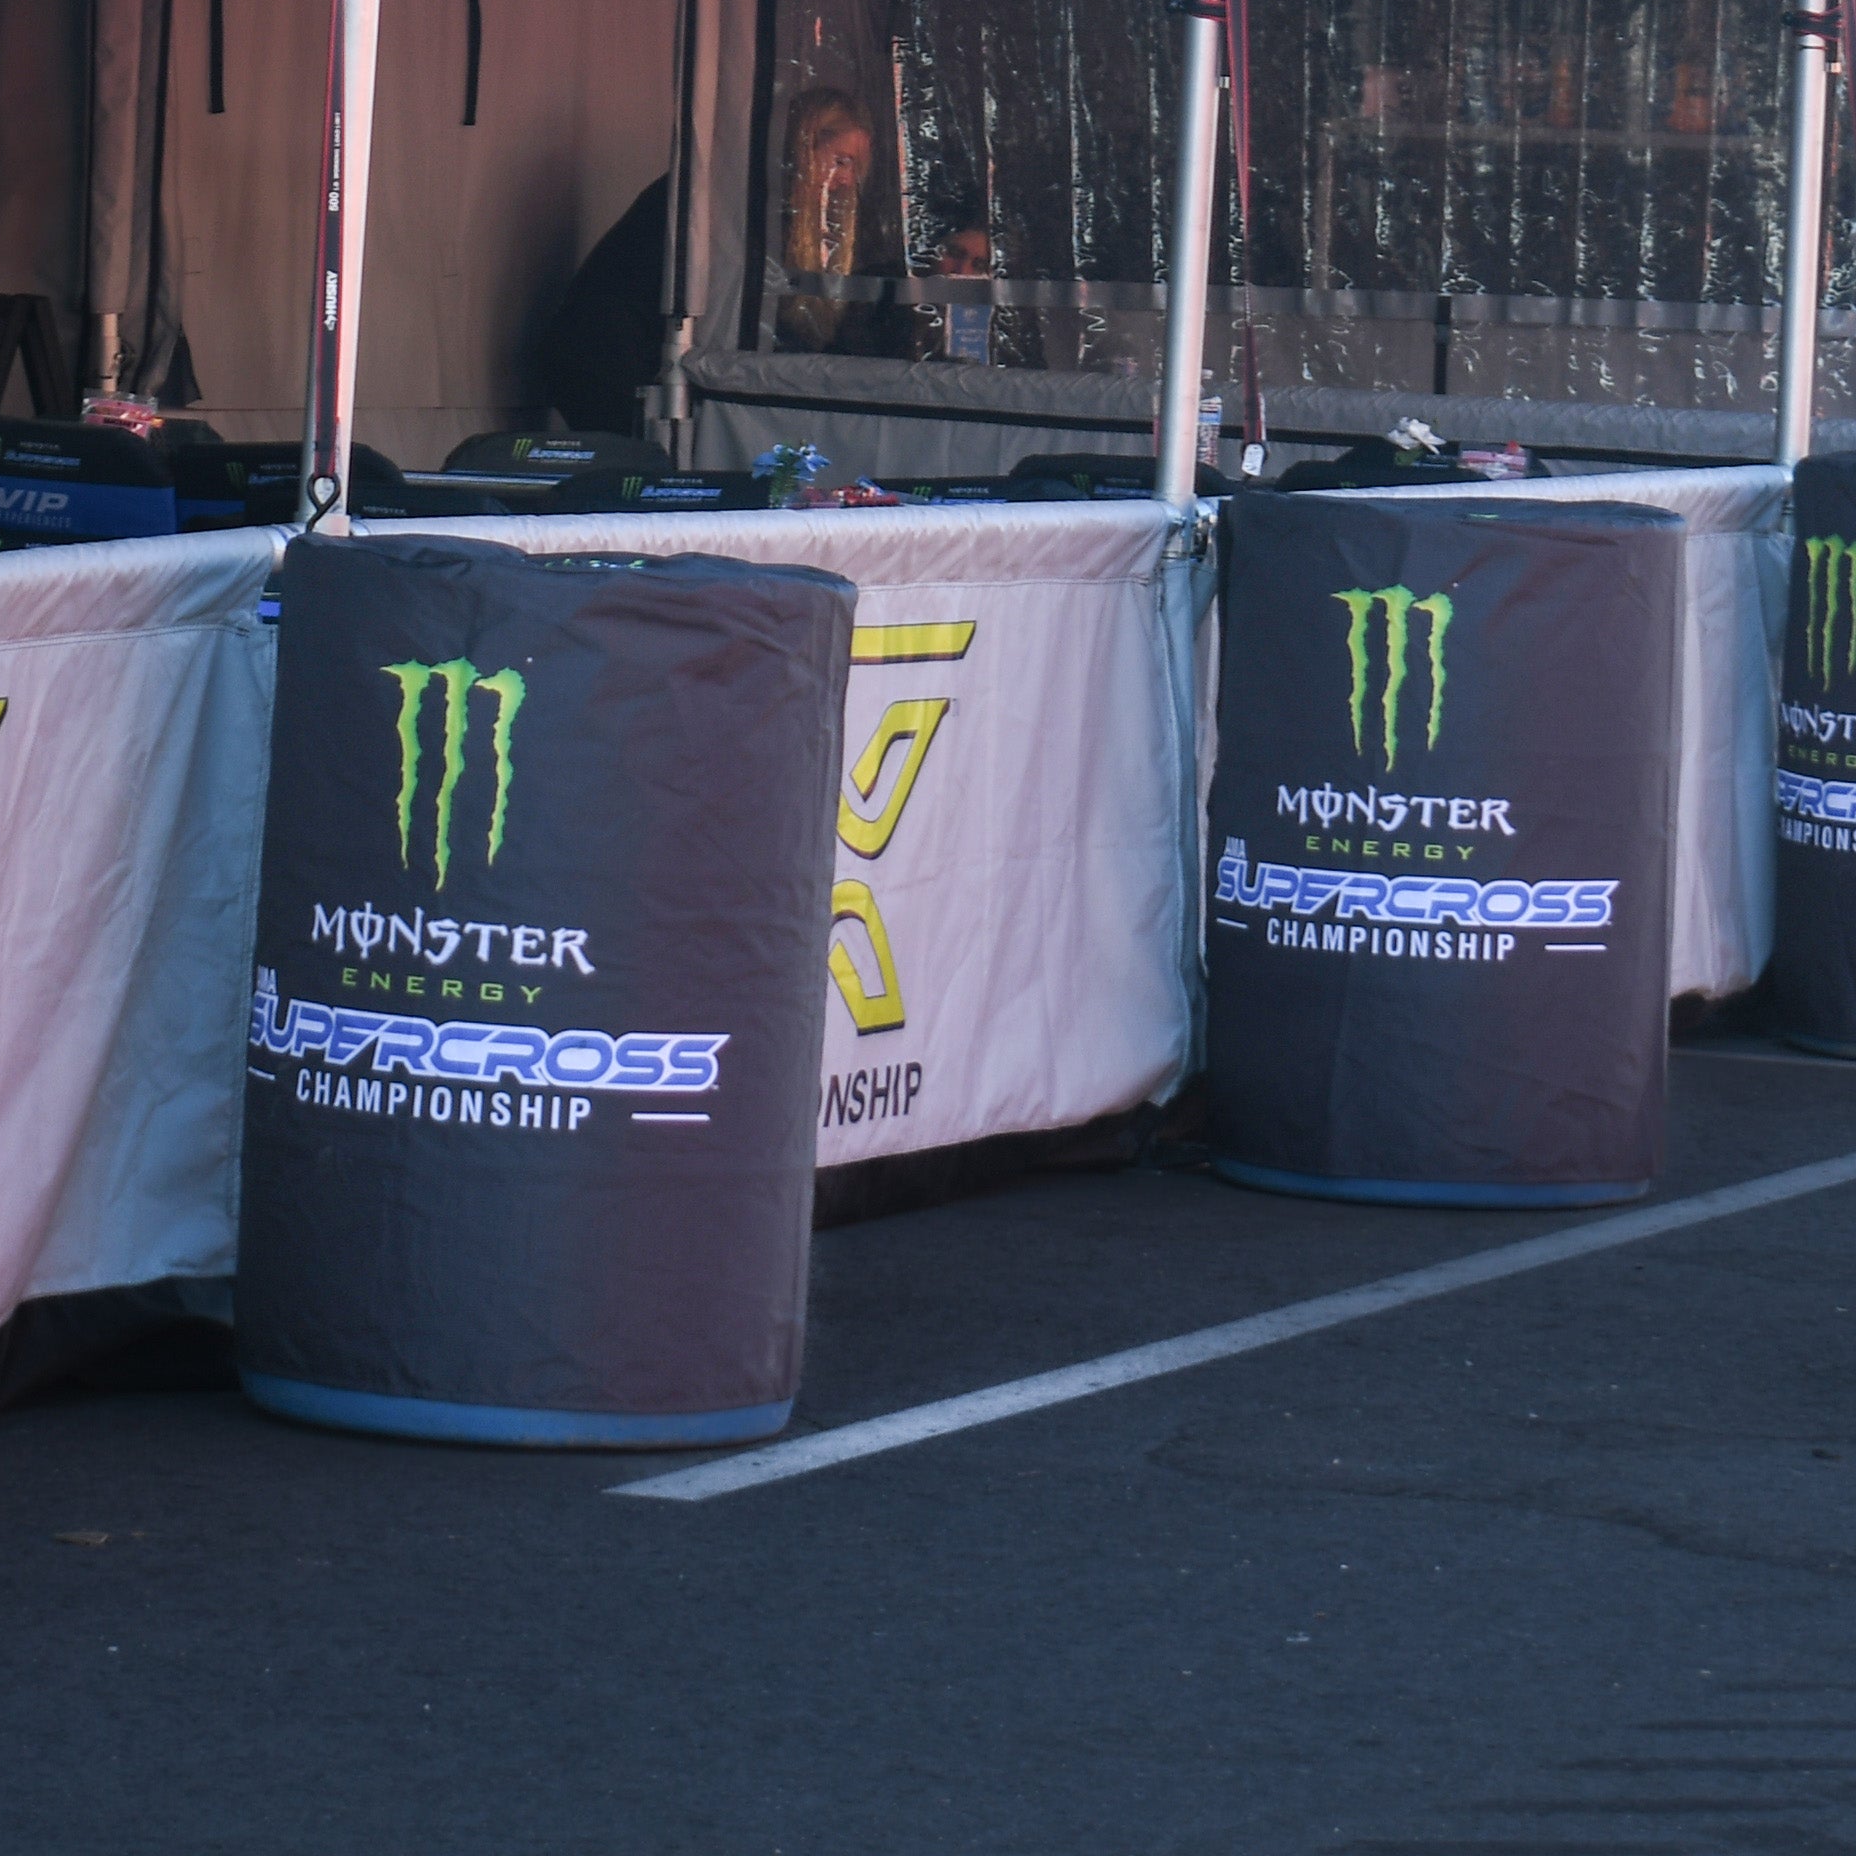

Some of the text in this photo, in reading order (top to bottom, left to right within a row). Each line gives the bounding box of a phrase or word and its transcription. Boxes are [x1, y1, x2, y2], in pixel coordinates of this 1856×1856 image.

[326, 271, 338, 315] HUSKY
[1276, 780, 1516, 836] MONSTER
[1305, 834, 1476, 862] ENERGY
[1214, 855, 1621, 928] SUPERCROSS
[310, 901, 595, 975] MONSTER
[1266, 916, 1516, 962] CHAMPIONSHIP
[341, 966, 542, 1005] ENERGY
[248, 994, 731, 1093] SUPERCROSS
[294, 1066, 593, 1131] CHAMPIONSHIP
